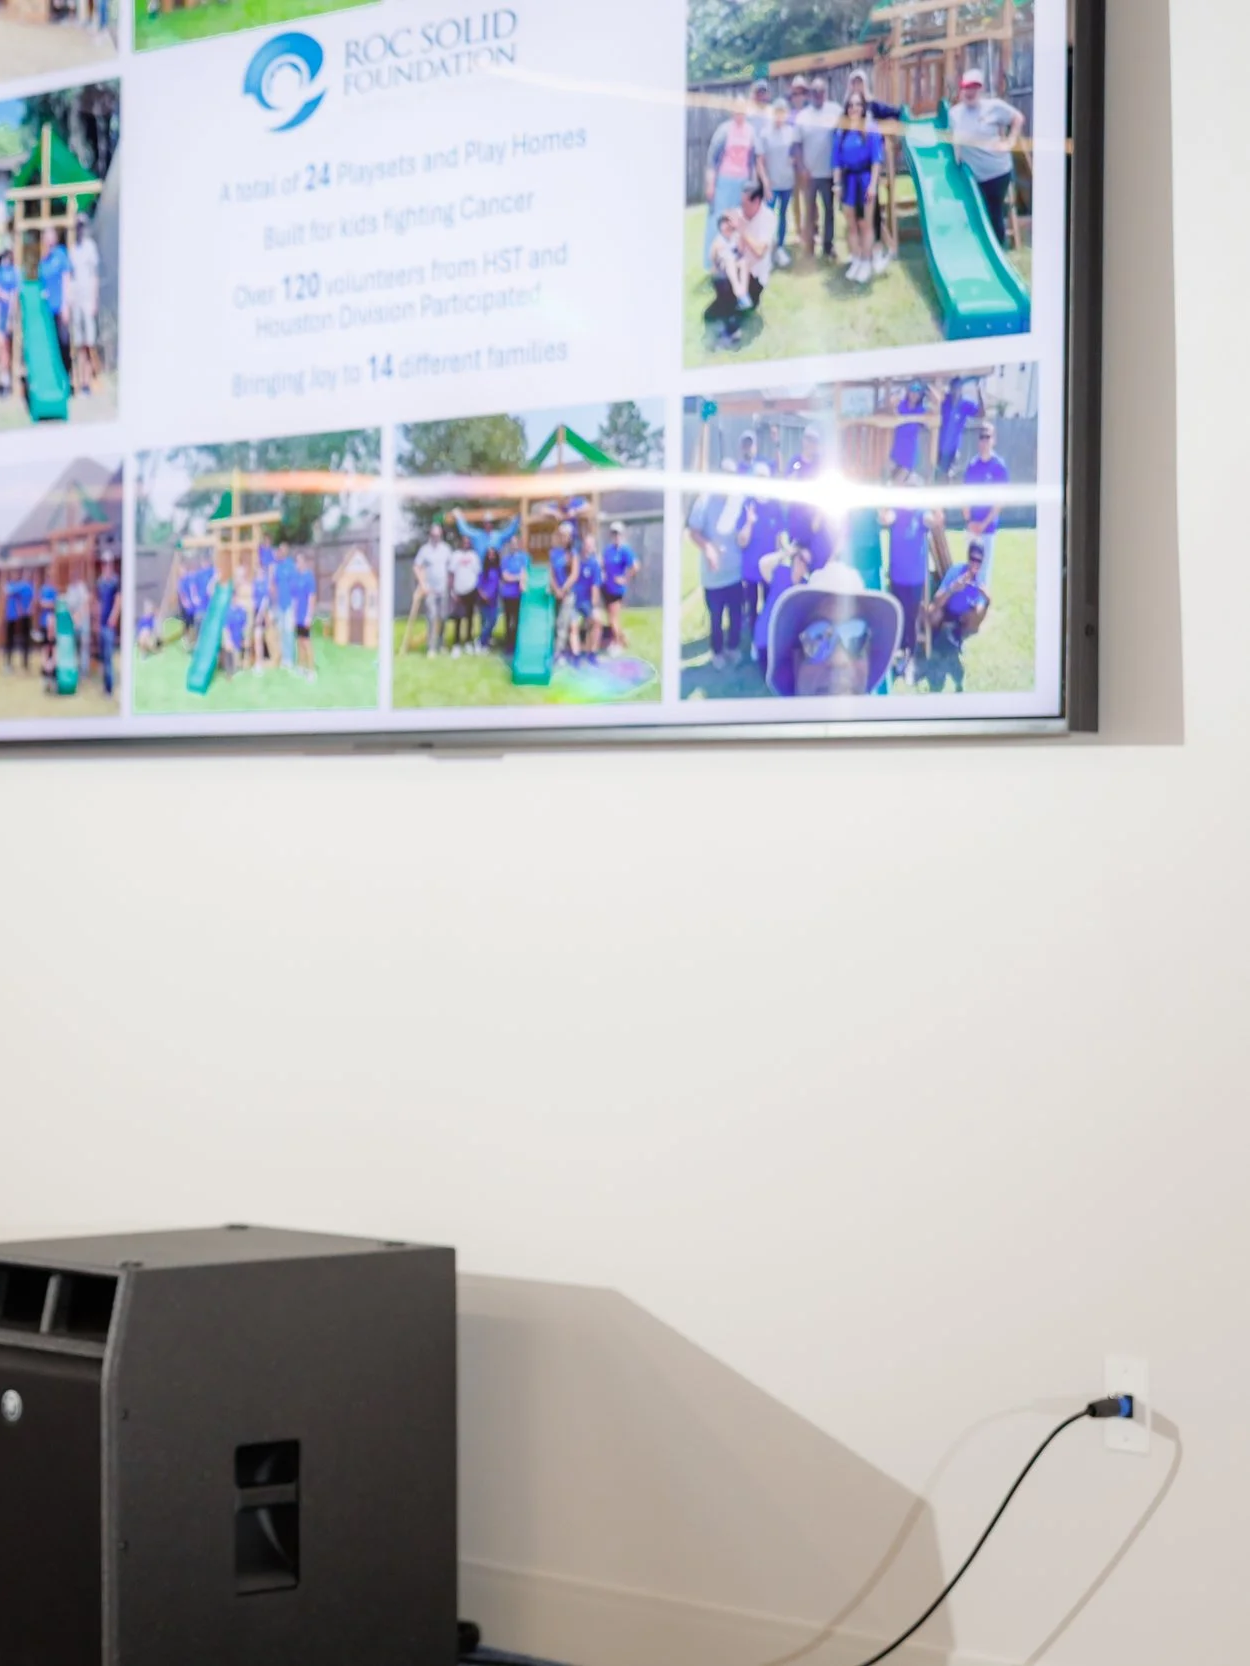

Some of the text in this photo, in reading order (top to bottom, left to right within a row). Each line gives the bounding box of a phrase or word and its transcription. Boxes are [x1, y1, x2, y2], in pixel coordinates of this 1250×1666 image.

[344, 8, 518, 69] ROC SOLID
[343, 43, 518, 96] FOUNDATION
[304, 162, 331, 191] 24
[336, 154, 417, 187] Playsets
[422, 145, 459, 173] and
[463, 138, 507, 166] Play
[511, 126, 587, 159] Homes
[263, 190, 536, 251] Built for kids fighting Cancer
[232, 240, 570, 309] Over 120 volunteers from HST and
[254, 313, 336, 340] Houston
[338, 300, 416, 330] Division
[366, 353, 395, 382] 14
[398, 348, 482, 380] different
[486, 341, 569, 370] families
